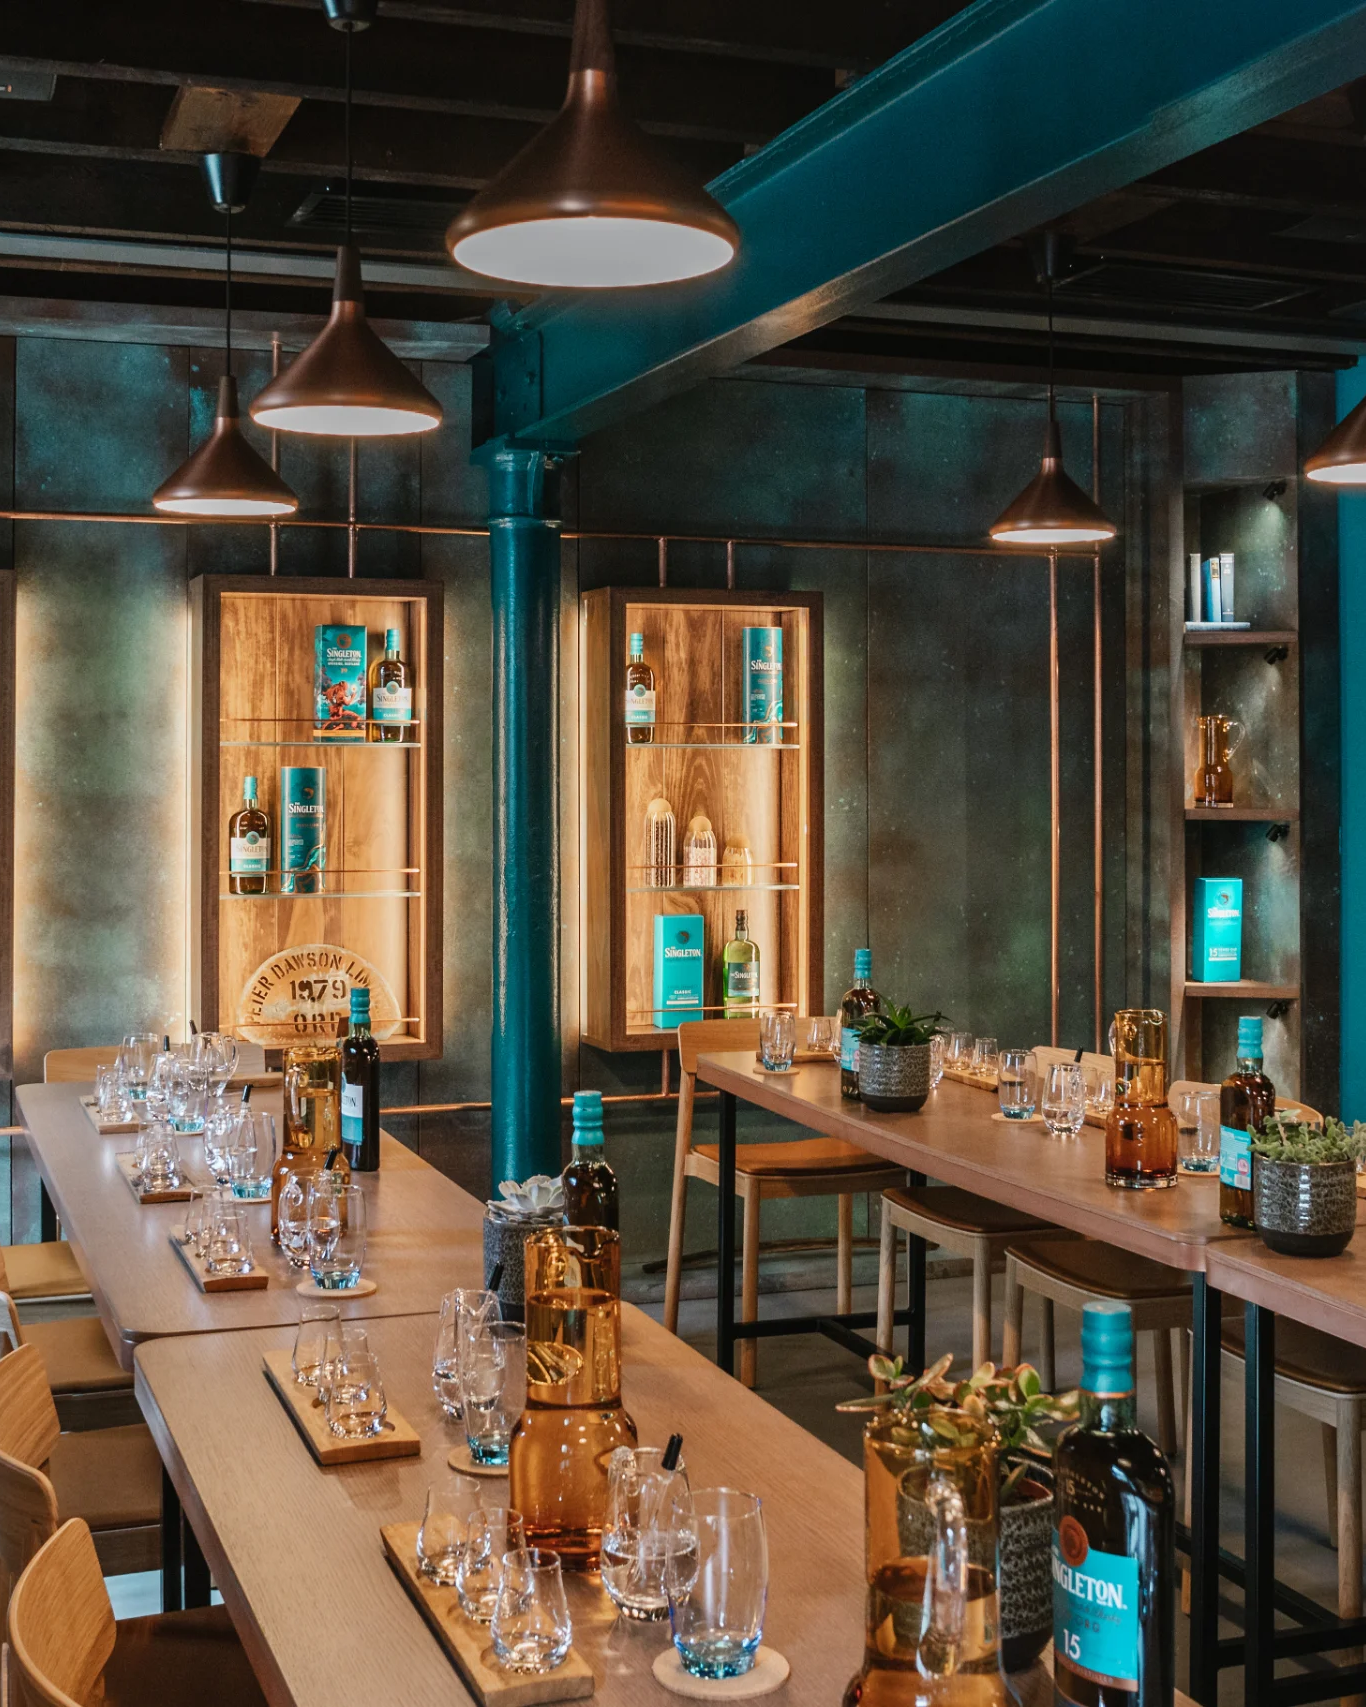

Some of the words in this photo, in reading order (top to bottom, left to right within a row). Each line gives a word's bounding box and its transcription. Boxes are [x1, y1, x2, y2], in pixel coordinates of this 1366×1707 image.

[271, 952, 343, 980] DAWSON
[664, 947, 701, 958] SINGLETON
[1063, 1628, 1081, 1660] 15
